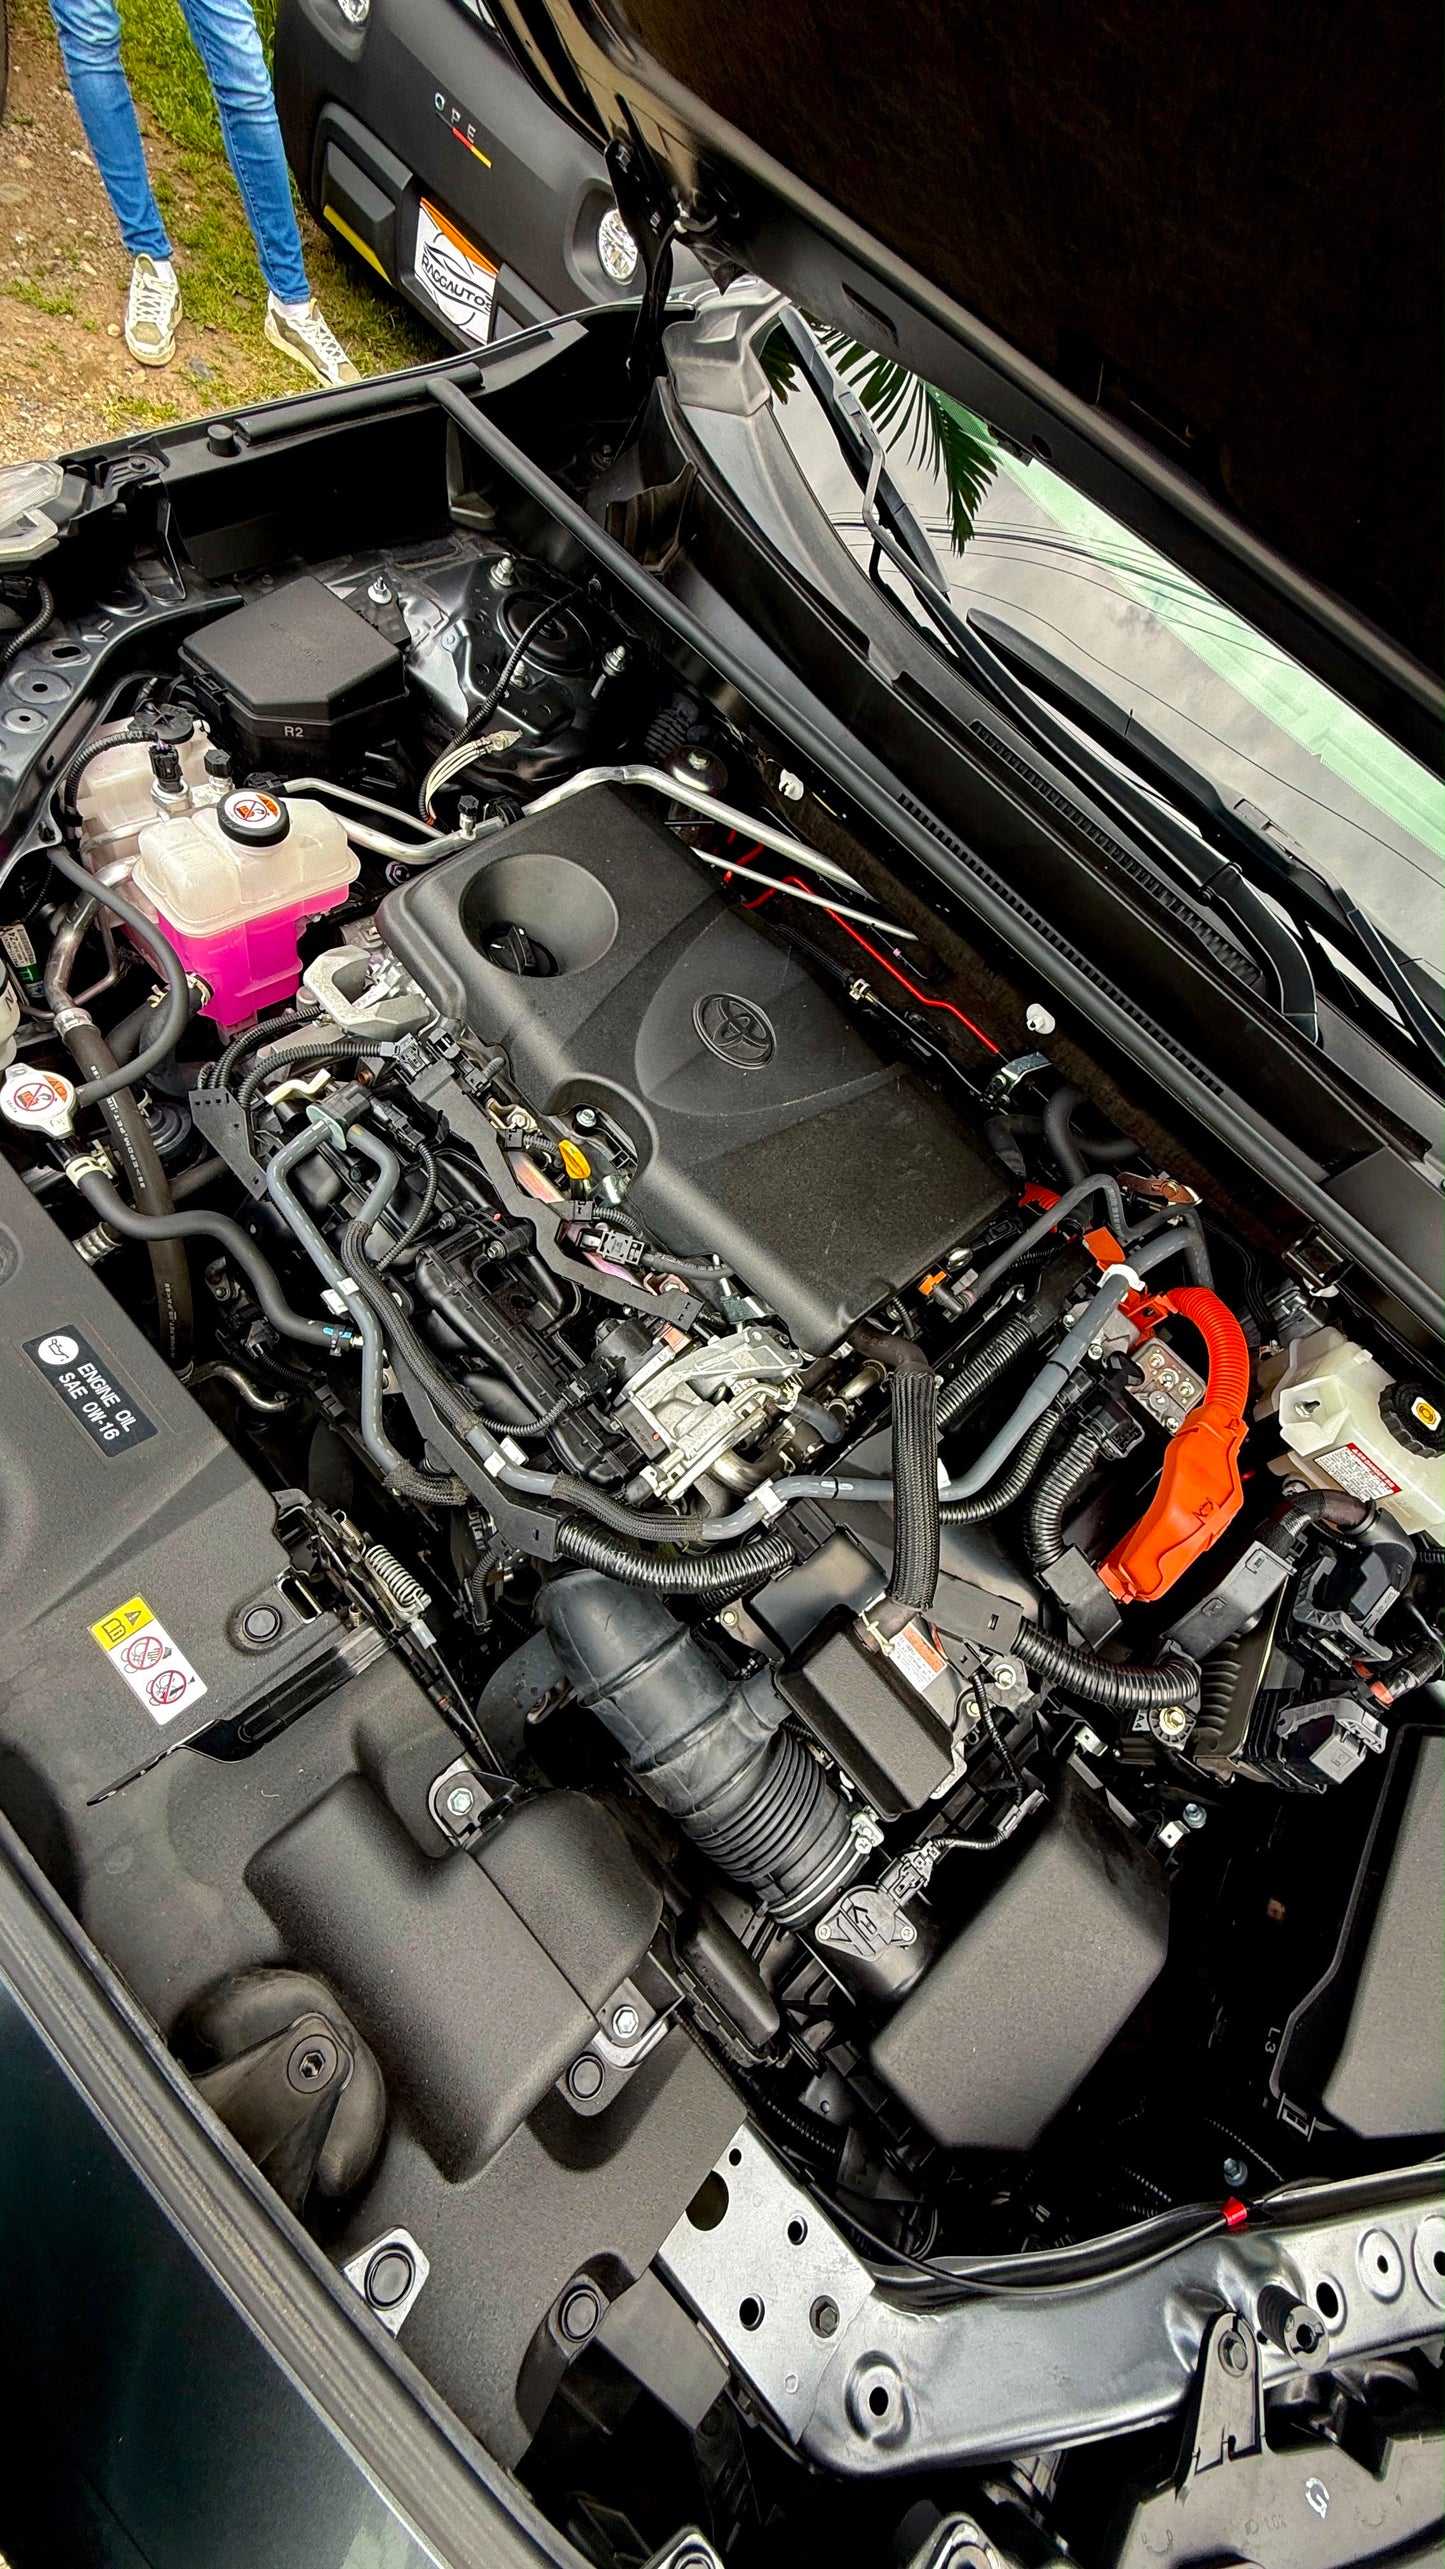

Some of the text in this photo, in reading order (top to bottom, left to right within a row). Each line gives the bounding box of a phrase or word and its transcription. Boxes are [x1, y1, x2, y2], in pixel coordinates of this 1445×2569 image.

[284, 725, 304, 738] R2
[58, 1372, 119, 1440] SAE 0W-16
[77, 1362, 137, 1432] ENGINE OIL
[1135, 1714, 1145, 1728] A4
[1265, 2026, 1281, 2053] L3
